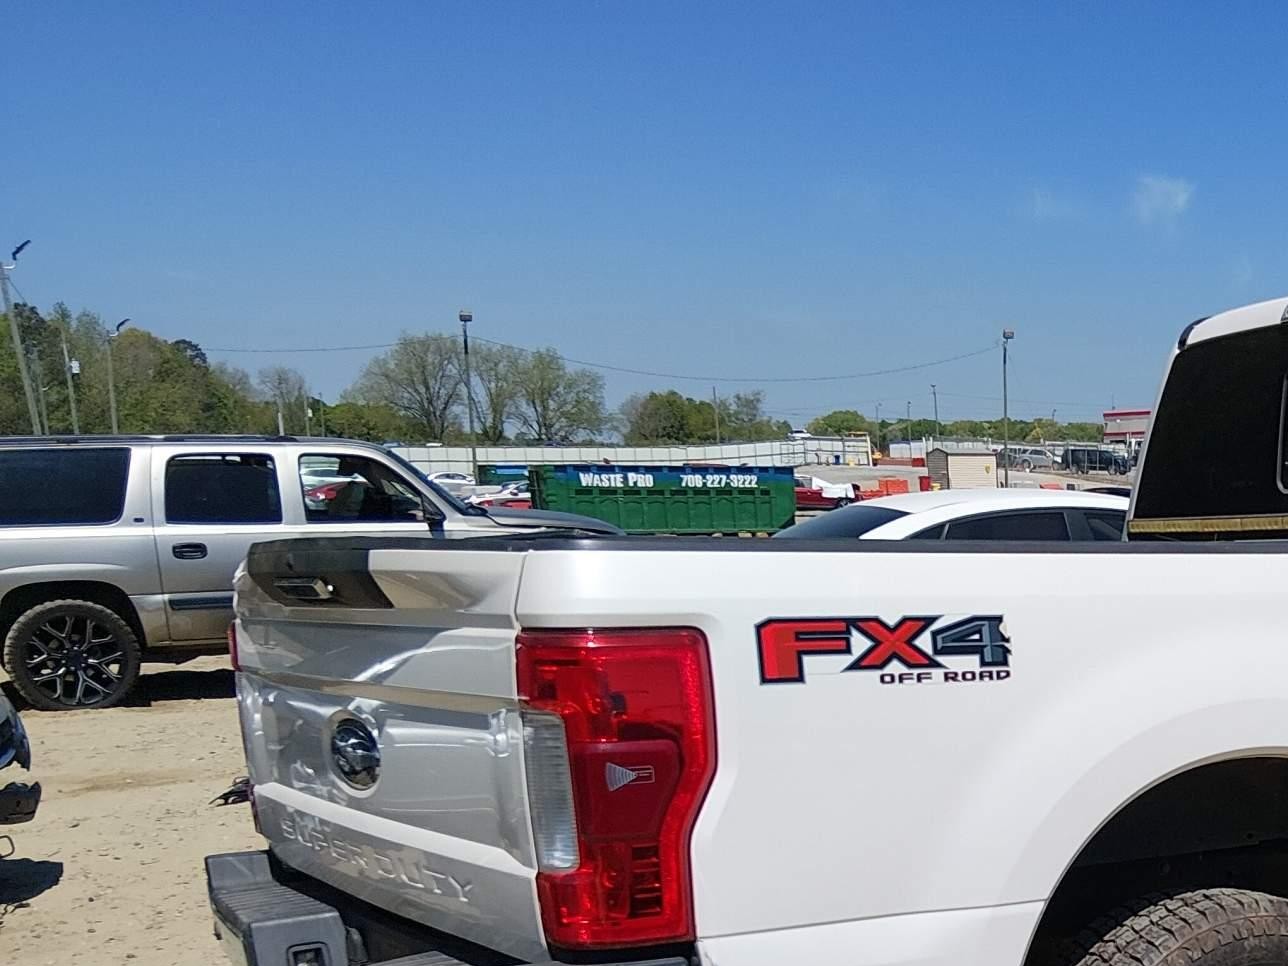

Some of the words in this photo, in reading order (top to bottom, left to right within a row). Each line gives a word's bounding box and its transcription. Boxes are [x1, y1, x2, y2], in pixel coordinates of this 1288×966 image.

[754, 615, 1012, 686] FX4
[879, 671, 933, 685] OFF
[943, 669, 1012, 684] ROAD
[279, 817, 370, 870] SUPER
[372, 852, 474, 902] DUTY
